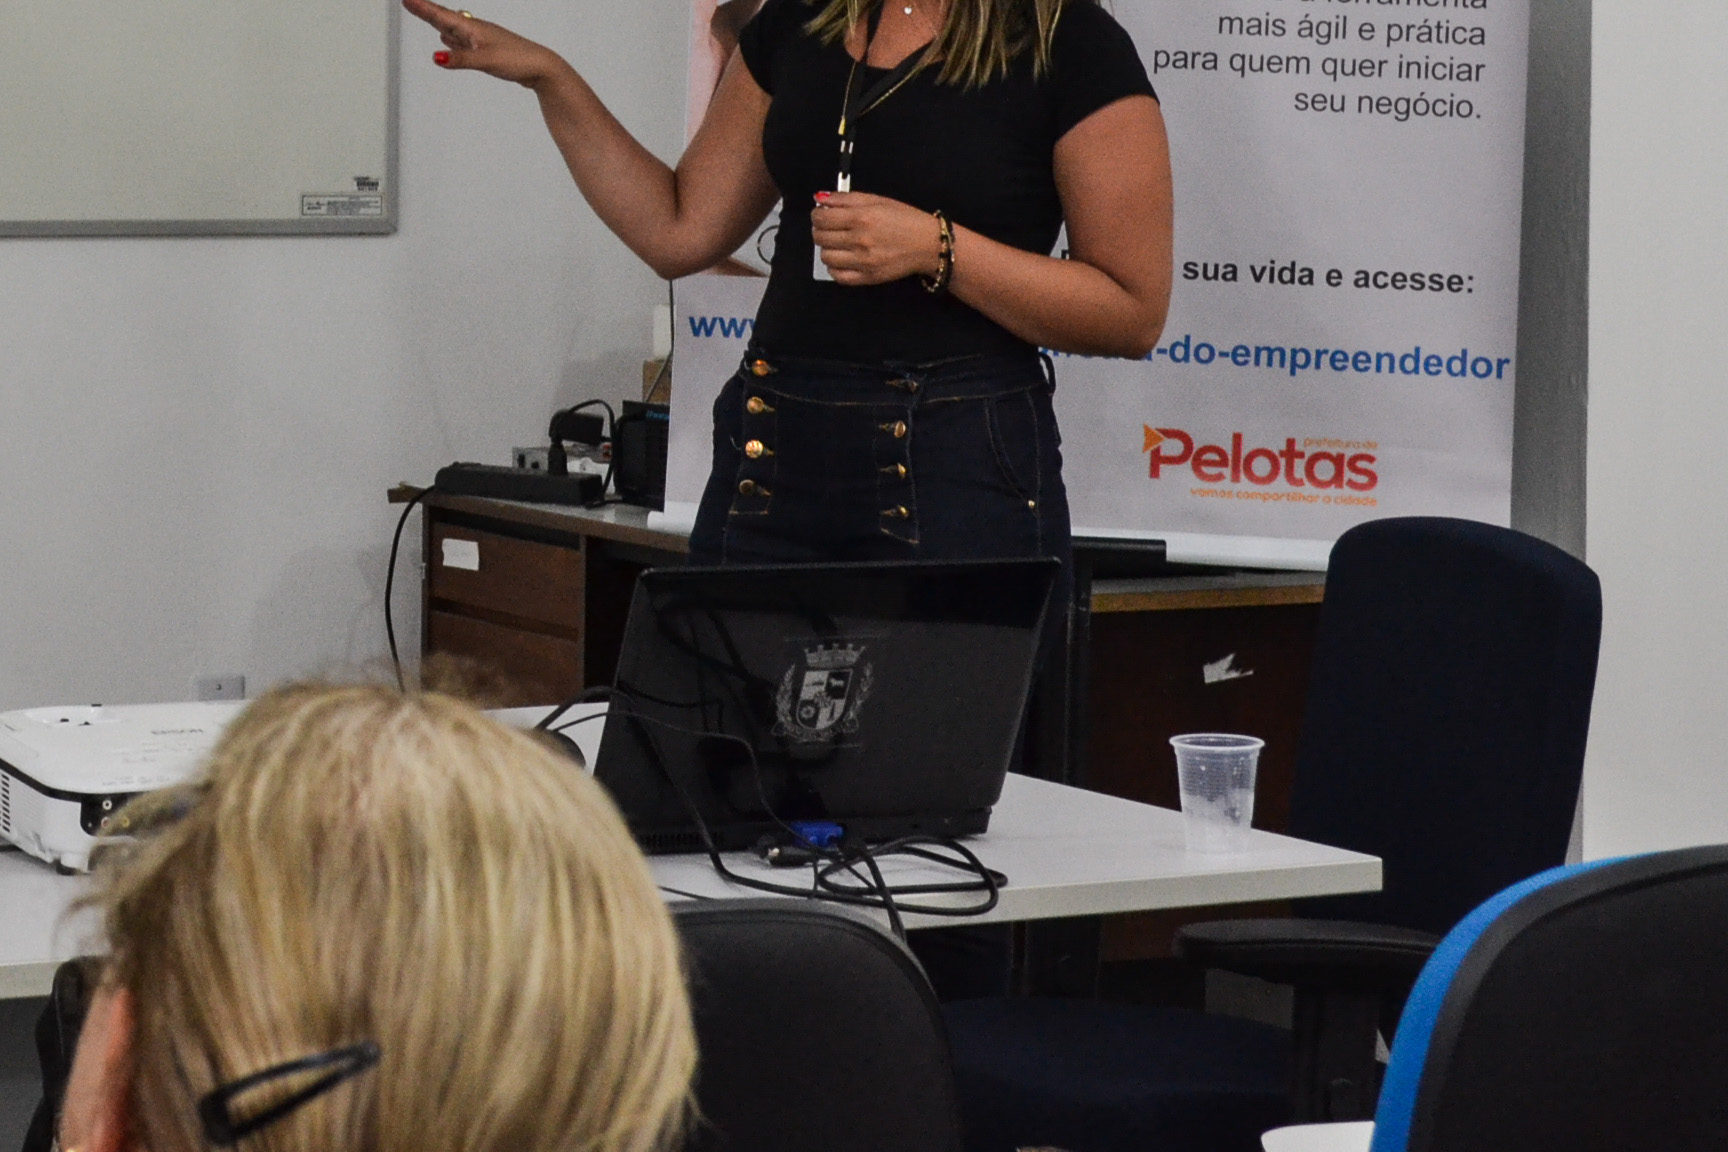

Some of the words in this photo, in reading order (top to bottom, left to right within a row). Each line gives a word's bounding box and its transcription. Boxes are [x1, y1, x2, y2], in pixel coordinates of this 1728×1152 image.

[1218, 11, 1285, 39] mais
[1297, 13, 1347, 47] ágil
[1358, 22, 1376, 43] e
[1386, 16, 1486, 50] prática
[1154, 47, 1218, 75] para
[1228, 51, 1311, 81] quem
[1321, 54, 1388, 82] quer
[1397, 54, 1486, 84] iniciar
[1294, 91, 1347, 115] seu
[1356, 89, 1482, 123] negócio.
[1183, 261, 1238, 282] sua
[1250, 260, 1314, 286] vida
[1326, 265, 1342, 287] e
[1353, 265, 1474, 294] acesse:
[1148, 428, 1378, 491] Pelotas
[1191, 487, 1233, 498] vamos
[1236, 489, 1319, 503] compartilhar
[1323, 495, 1331, 504] a
[1334, 495, 1377, 506] cidade
